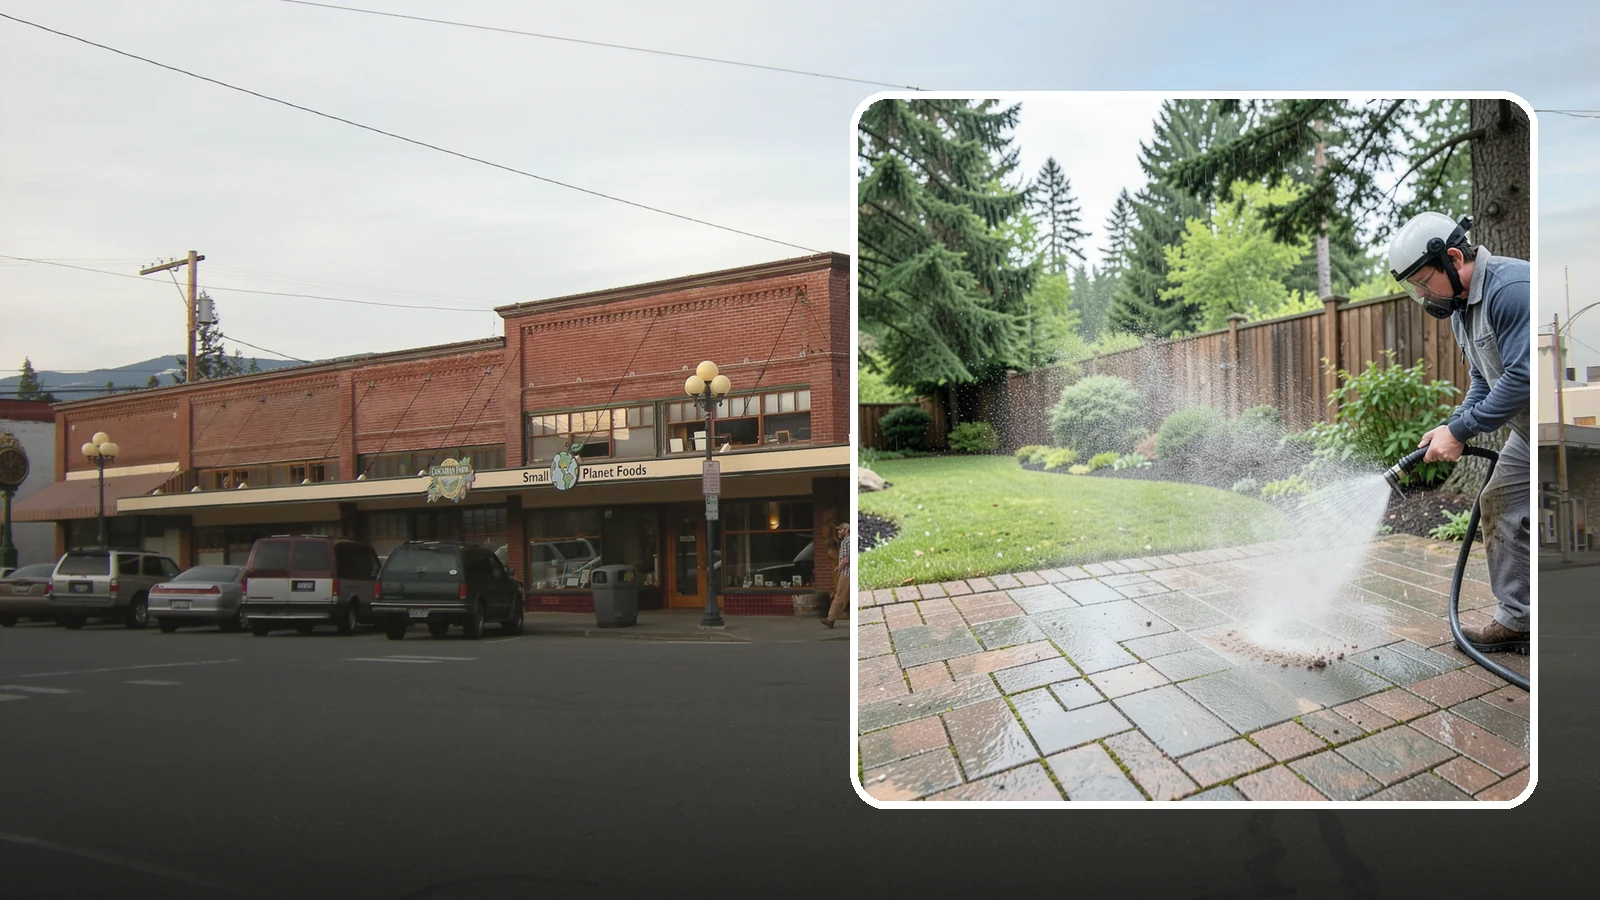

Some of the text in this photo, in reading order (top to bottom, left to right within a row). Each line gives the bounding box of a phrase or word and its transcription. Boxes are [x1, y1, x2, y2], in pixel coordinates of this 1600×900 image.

[523, 464, 647, 483] Small Planet Foods
